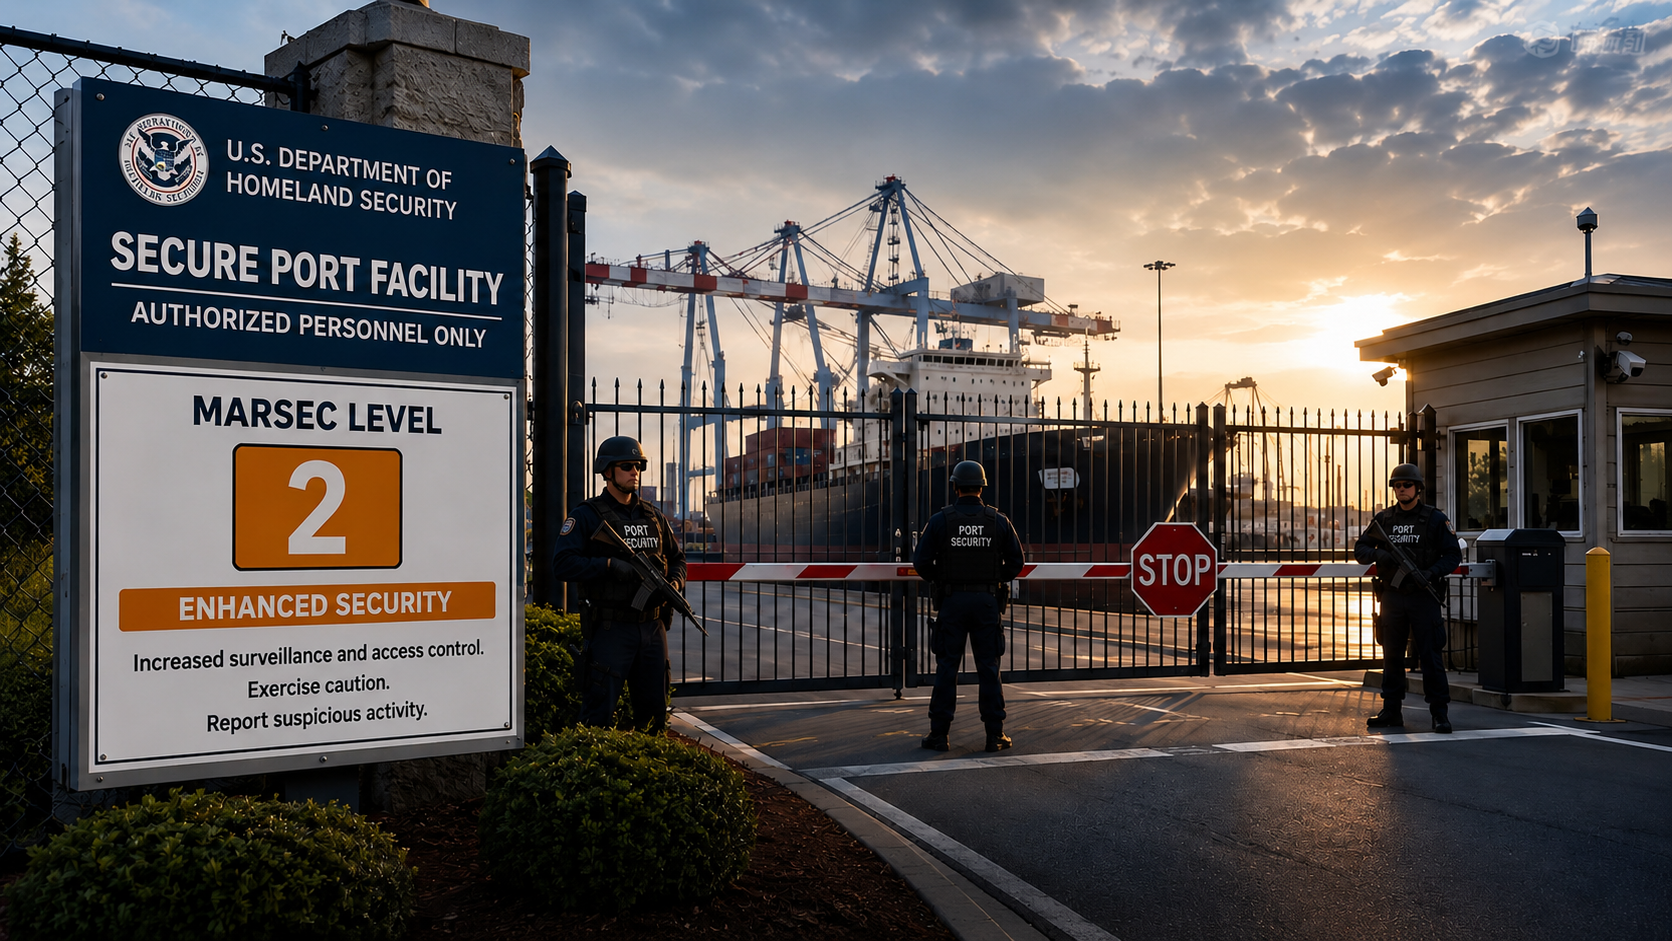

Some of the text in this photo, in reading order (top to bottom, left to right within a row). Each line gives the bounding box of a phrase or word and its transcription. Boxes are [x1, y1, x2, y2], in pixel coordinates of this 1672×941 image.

[228, 139, 451, 189] U.S. DEPARTMENT OF
[228, 171, 353, 207] HOMELAND
[360, 190, 457, 220] SECURITY
[110, 231, 503, 306] SECURE PORT FACILITY
[131, 301, 486, 347] AUTHORIZED PERSONNEL ONLY
[194, 395, 441, 434] MARSEC LEVEL
[288, 460, 346, 554] 2
[624, 525, 648, 536] PORT
[624, 537, 658, 549] ECURITY
[951, 537, 991, 547] SECURITY
[959, 525, 984, 536] PORT
[1392, 525, 1415, 534] PORT
[1139, 553, 1211, 587] STOP
[180, 591, 451, 620] ENHANCED SECURITY
[134, 639, 483, 671] Increased surveillance and access control.
[249, 674, 389, 698] Exercise caution.
[208, 701, 427, 734] Report suspicious activity.
